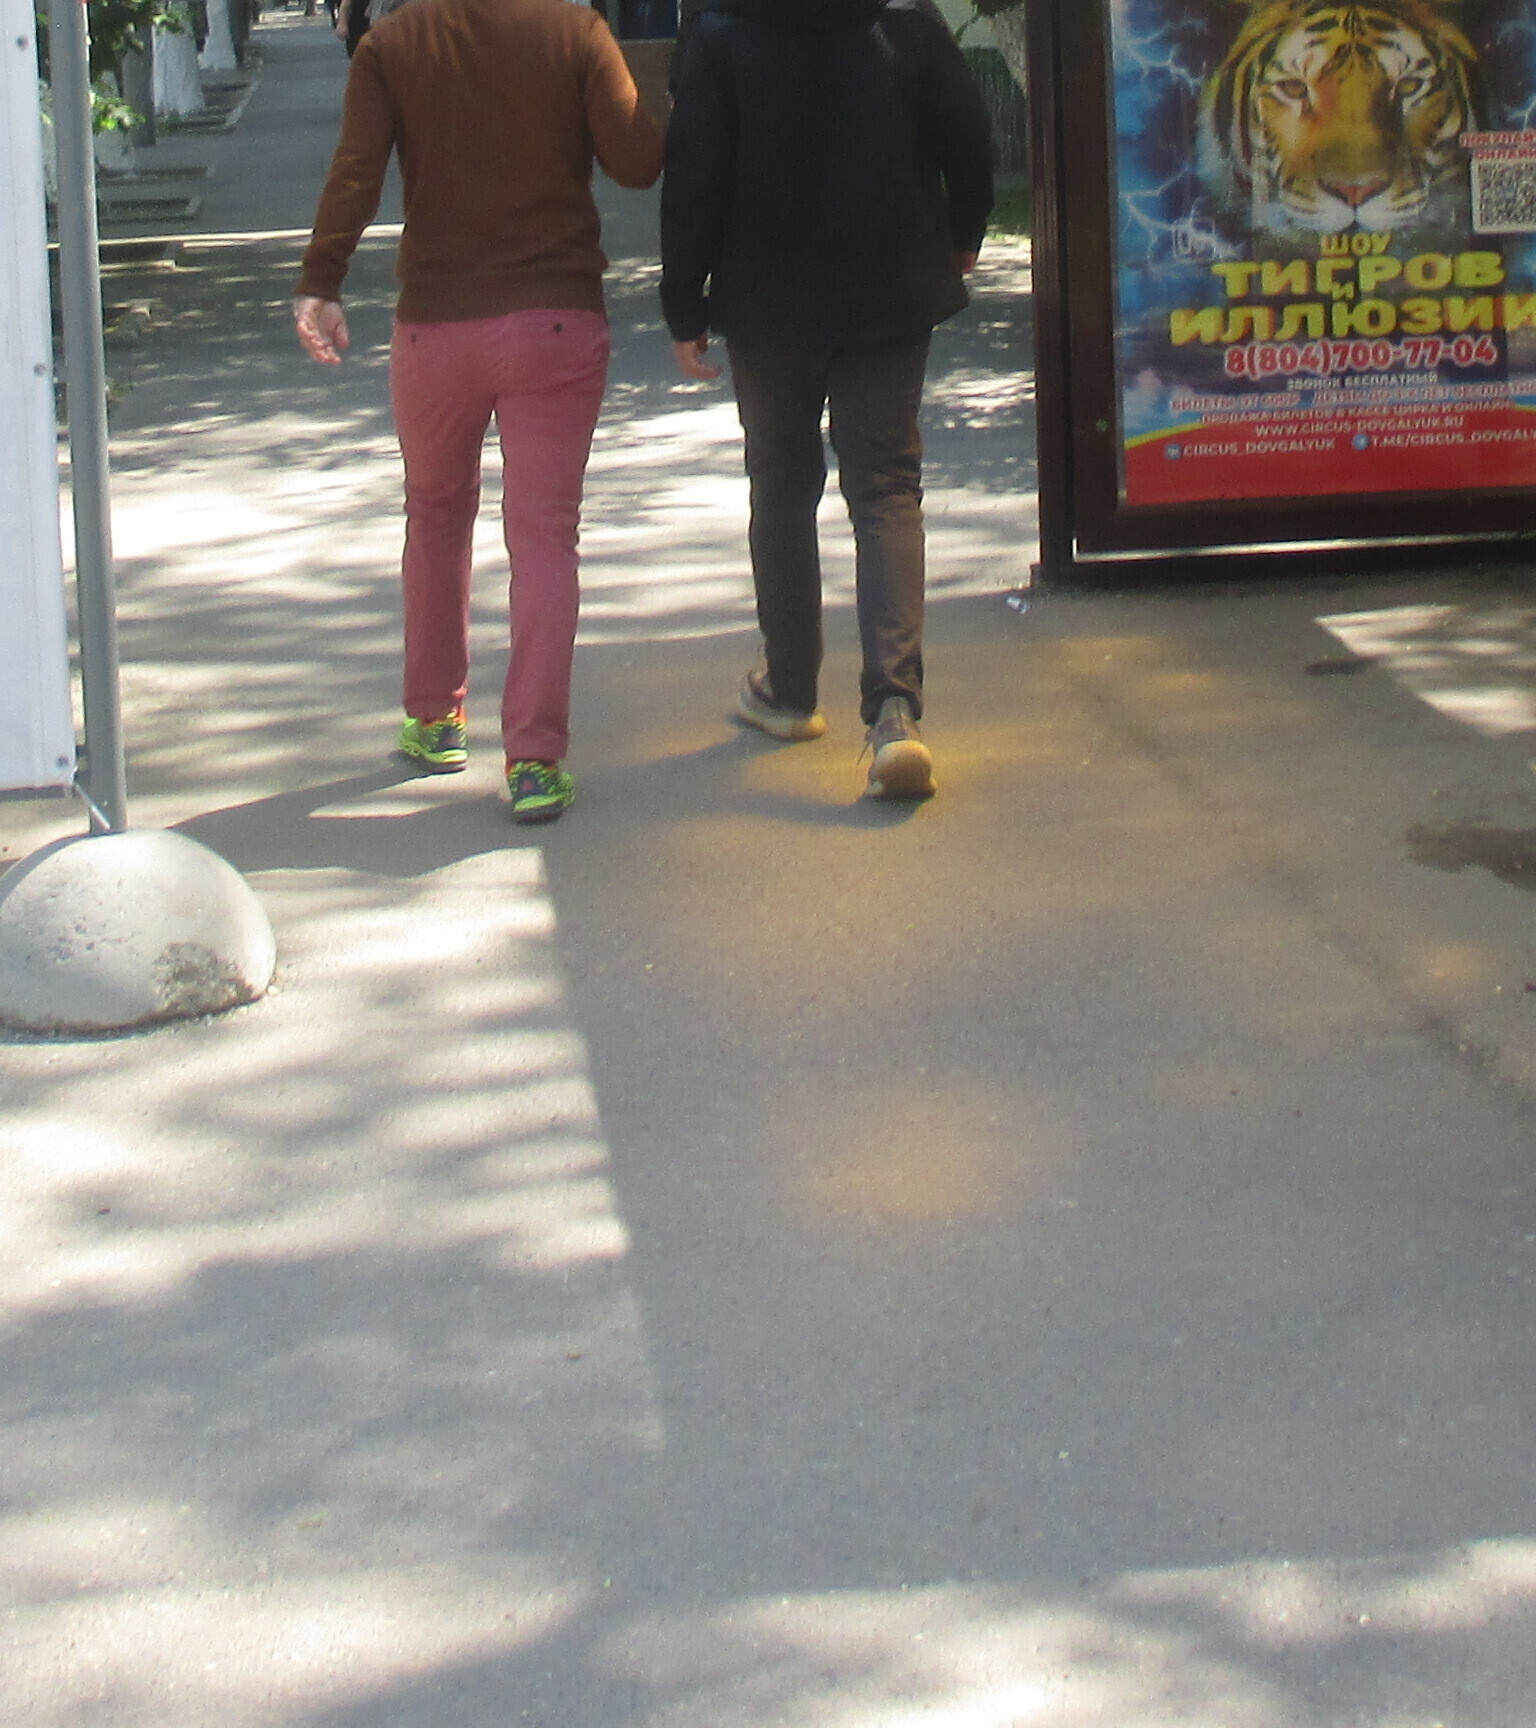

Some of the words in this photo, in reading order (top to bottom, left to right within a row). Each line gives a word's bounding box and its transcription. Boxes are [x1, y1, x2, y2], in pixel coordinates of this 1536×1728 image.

[1320, 232, 1392, 257] ШОУ
[1210, 250, 1507, 299] ТИГРОВ
[1225, 335, 1498, 378] 8(804)700-77-04
